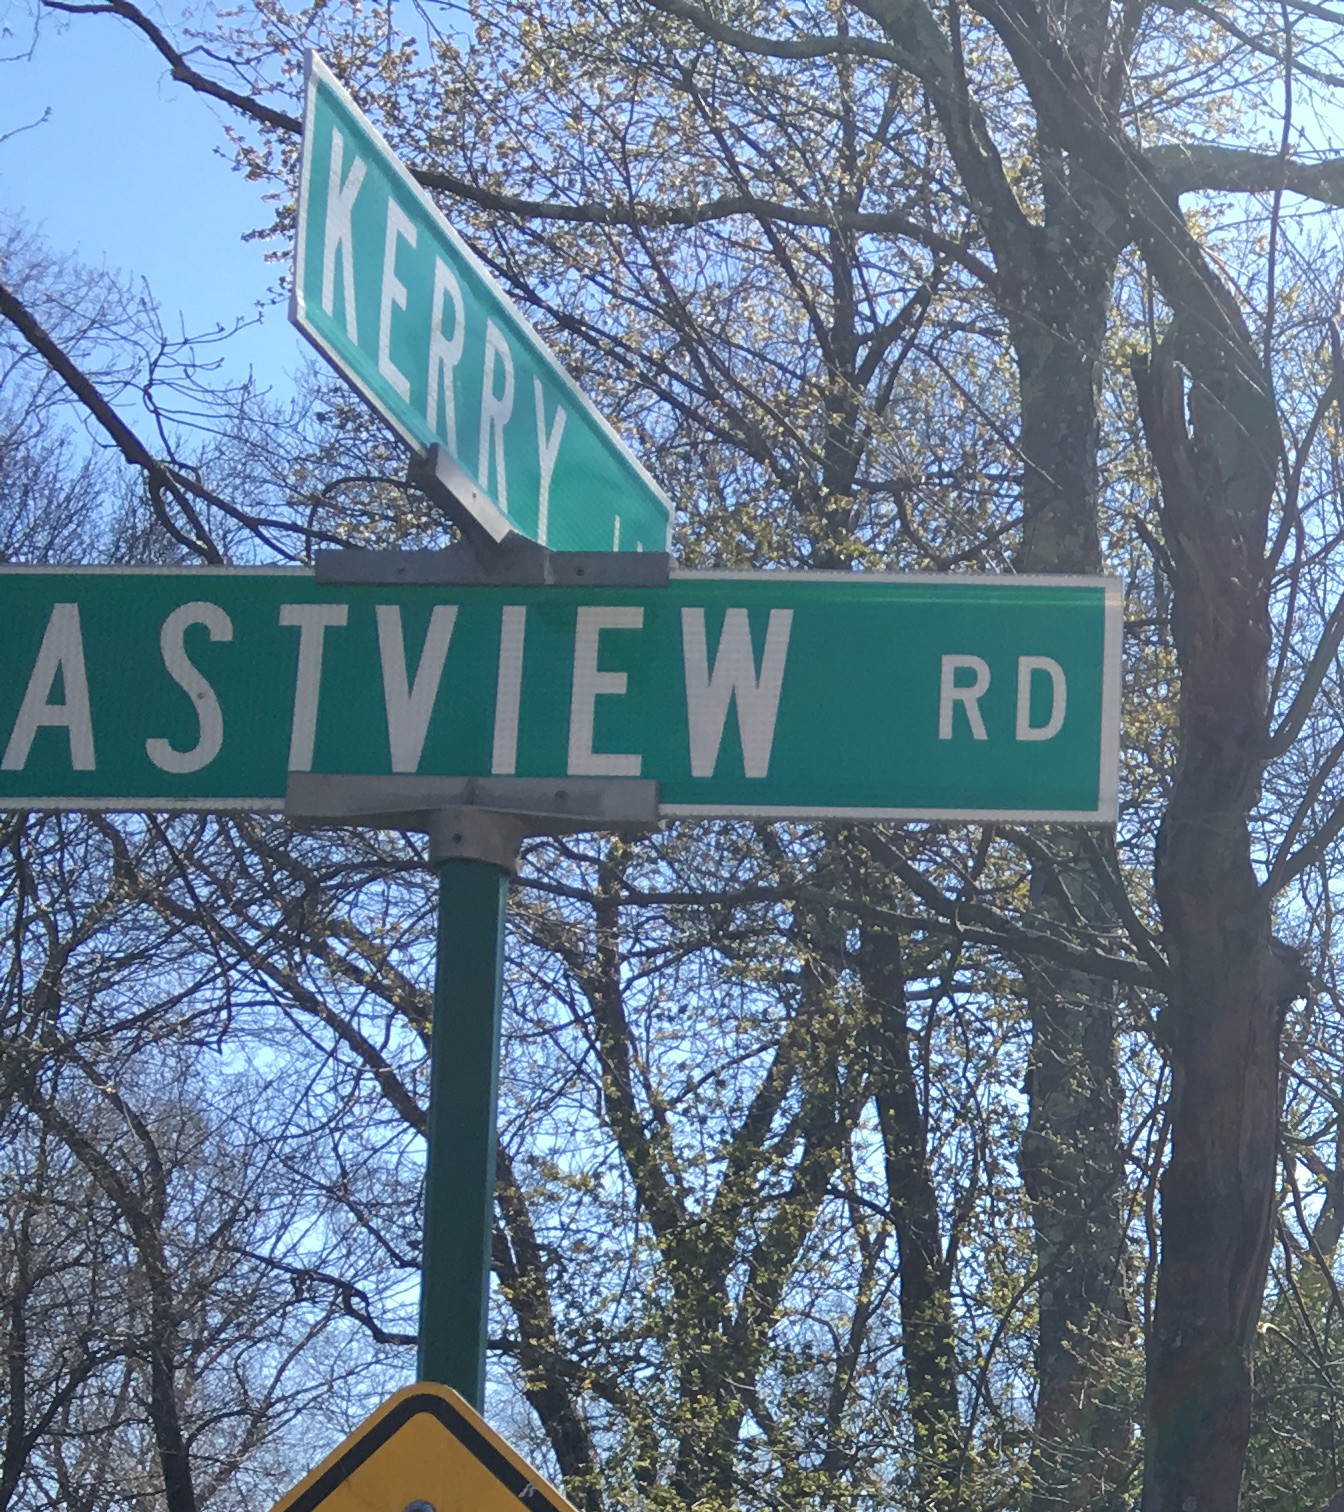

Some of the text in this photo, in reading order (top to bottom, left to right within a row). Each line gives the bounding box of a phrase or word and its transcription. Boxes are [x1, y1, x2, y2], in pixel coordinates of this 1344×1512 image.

[322, 125, 567, 547] KERRY
[1, 602, 1067, 779] ASTVIEW RD
